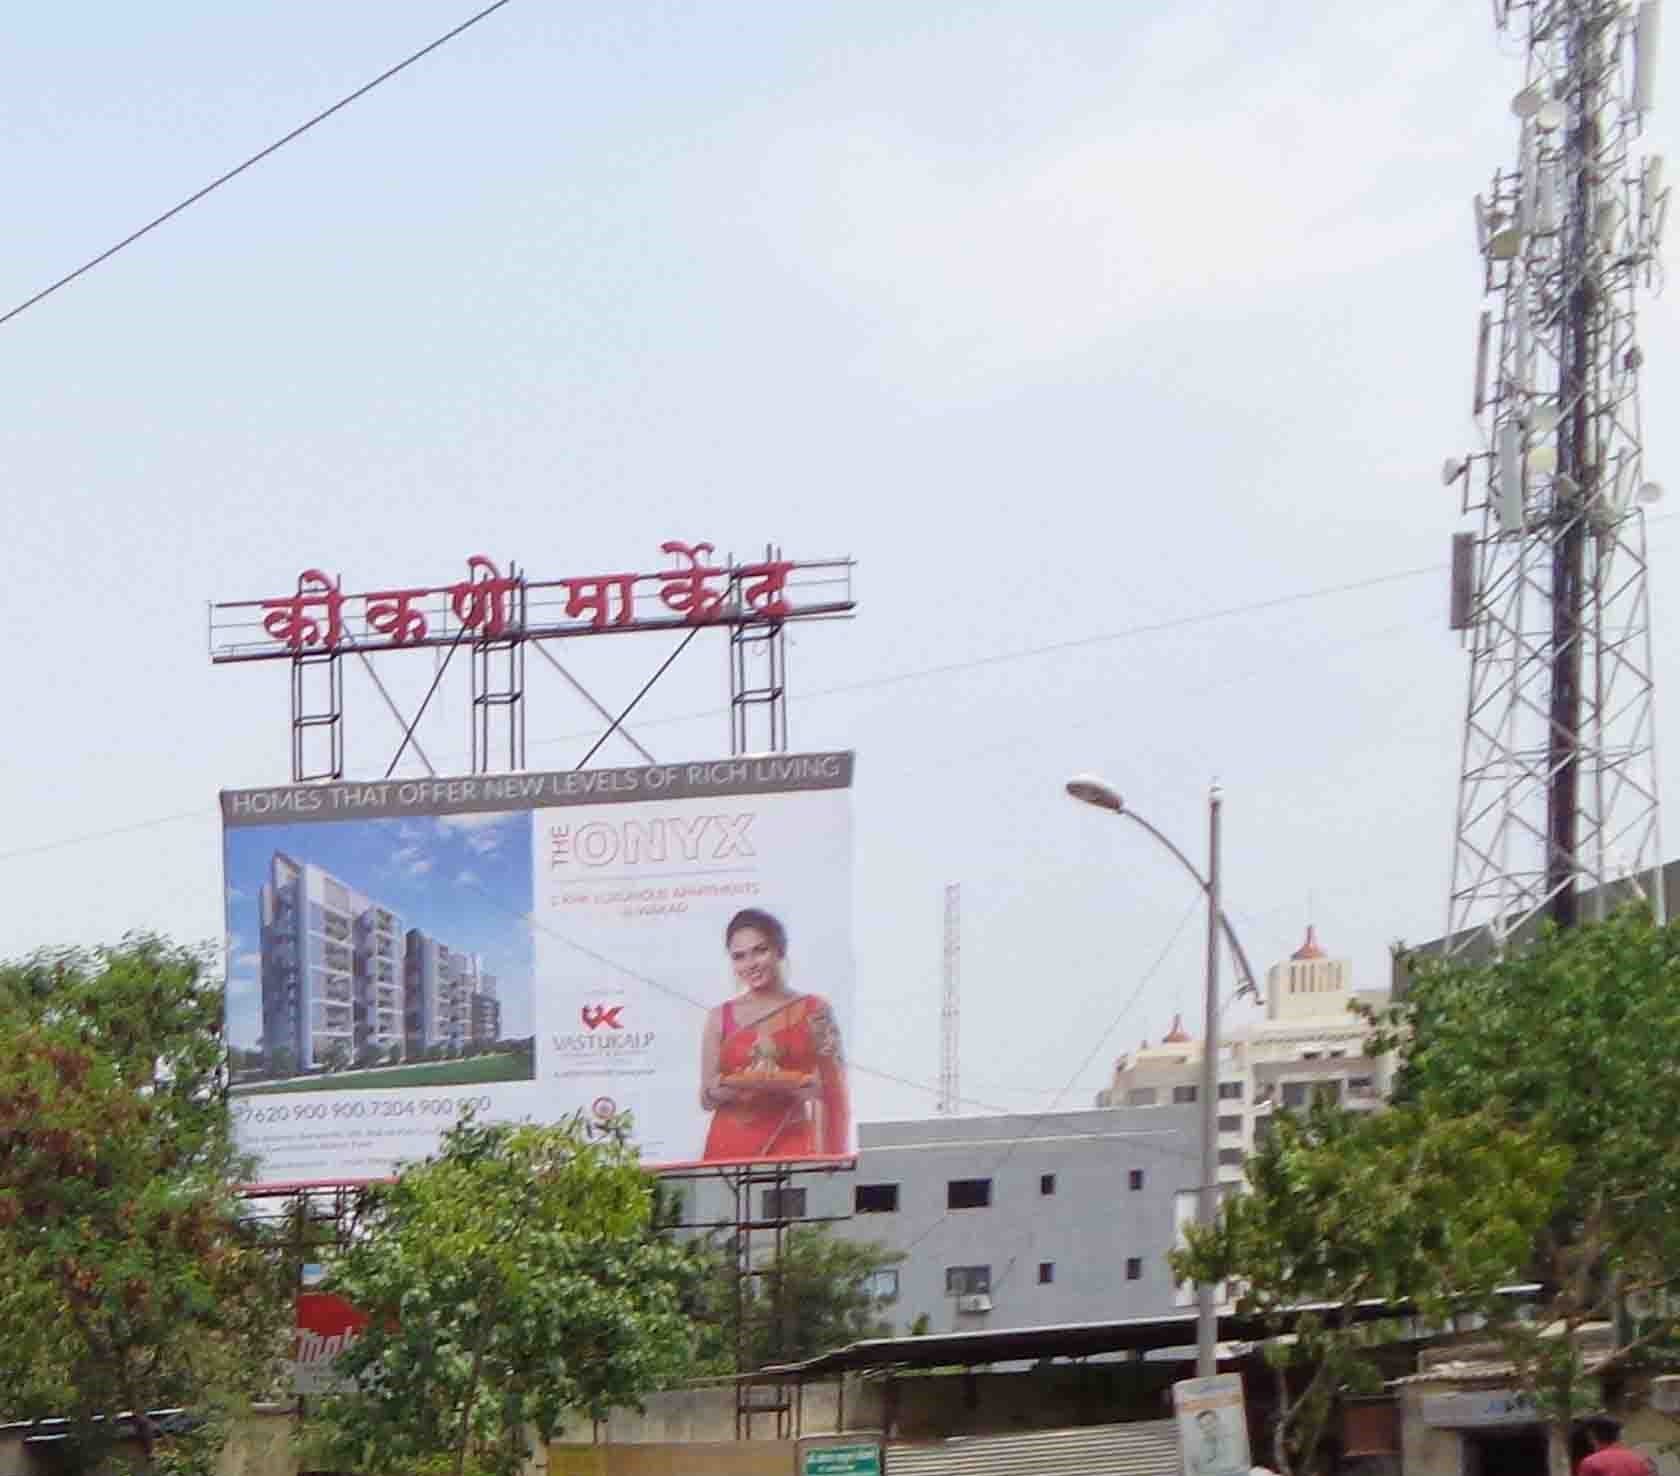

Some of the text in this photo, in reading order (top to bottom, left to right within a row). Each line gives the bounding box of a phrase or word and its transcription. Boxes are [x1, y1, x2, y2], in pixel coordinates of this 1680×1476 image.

[233, 756, 840, 814] HOMES THAT OFFER NEW LEVELS OF RICH LIVING
[551, 824, 569, 869] THE
[574, 814, 757, 867] ONYX
[293, 1102, 328, 1122] 900
[420, 1097, 454, 1115] 900
